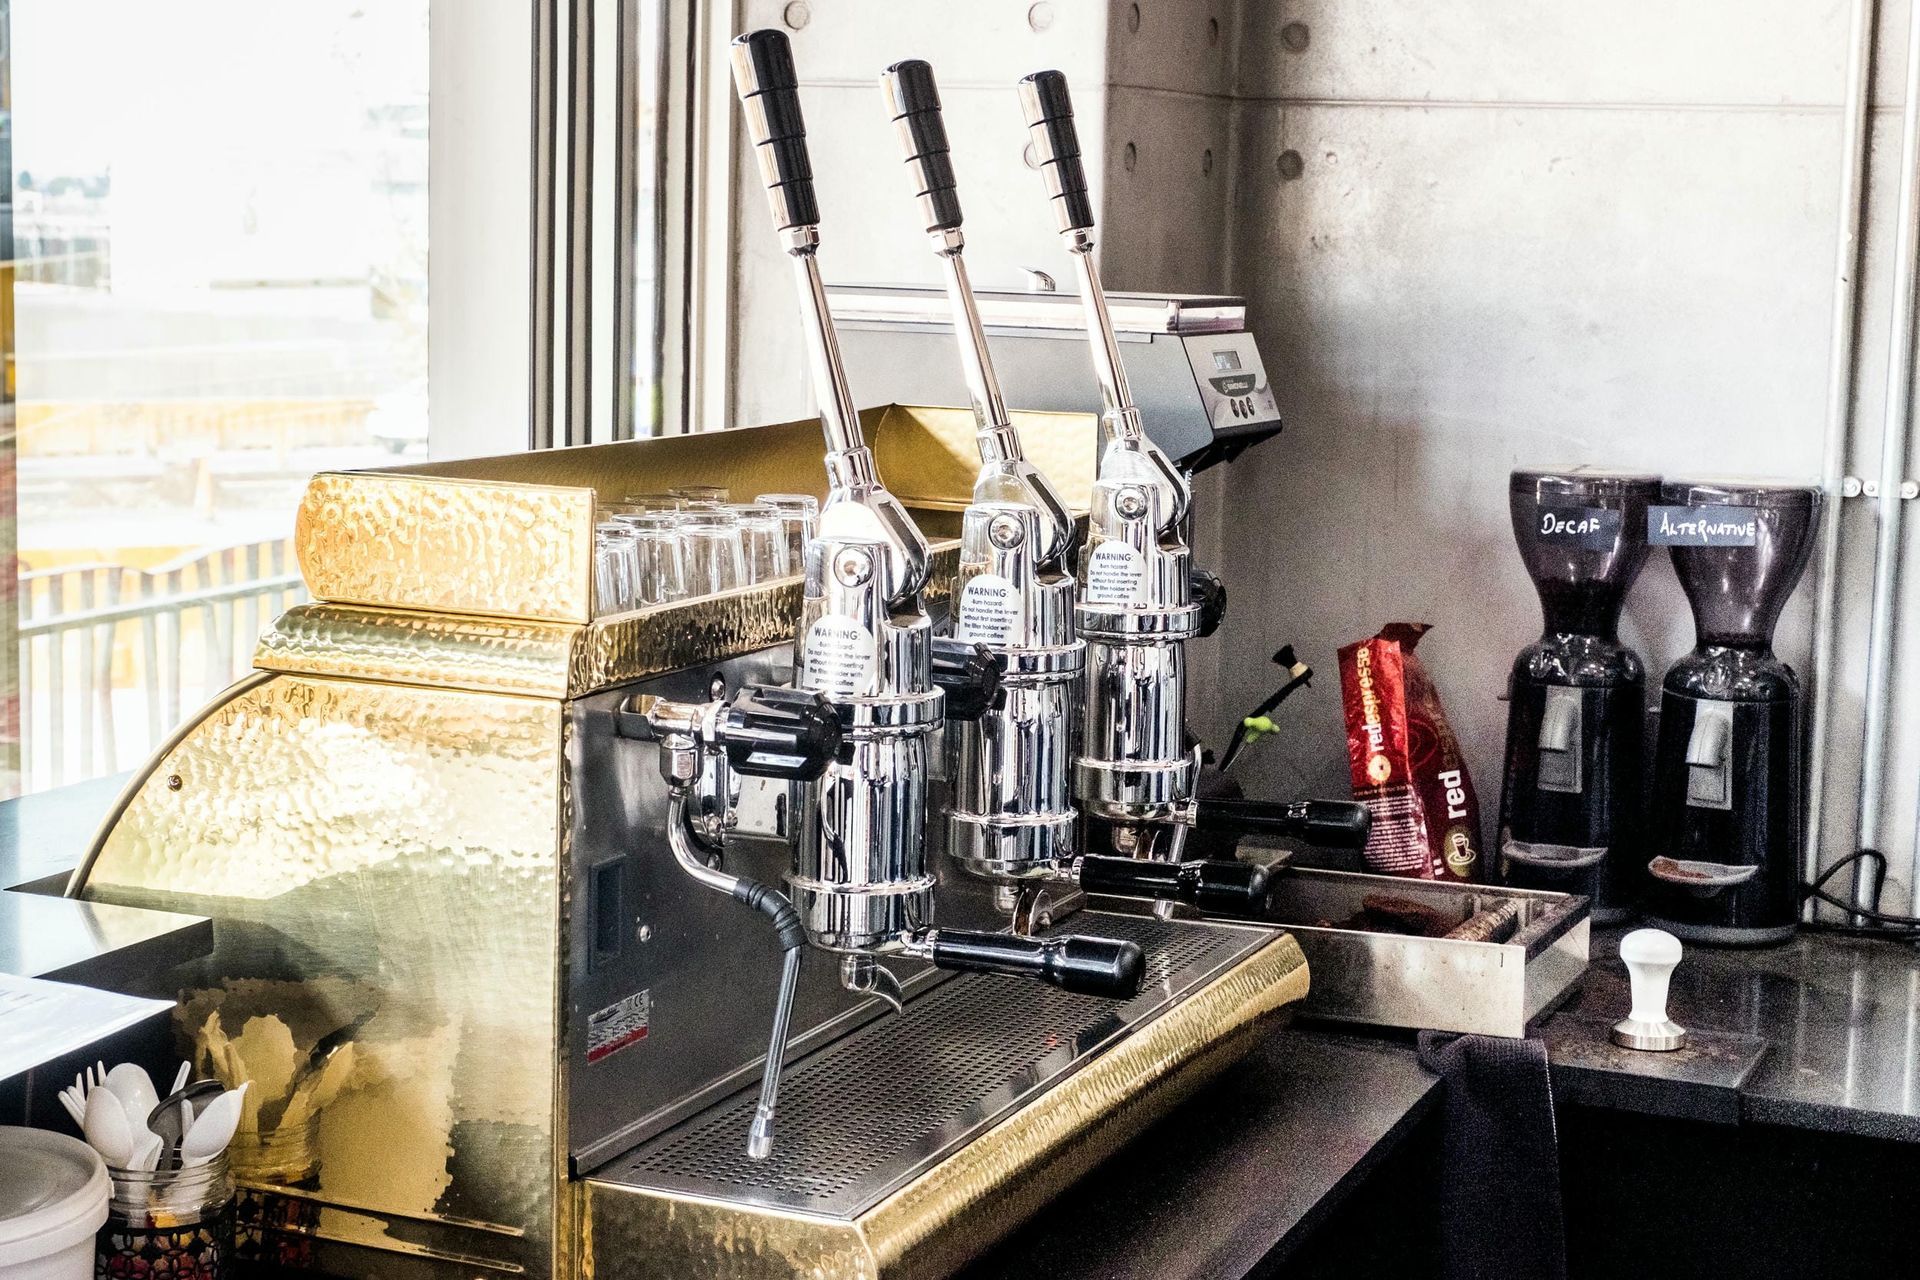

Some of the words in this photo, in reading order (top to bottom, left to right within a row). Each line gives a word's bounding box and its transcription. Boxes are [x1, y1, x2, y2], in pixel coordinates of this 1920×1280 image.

[1541, 513, 1600, 534] DECAF
[1660, 512, 1756, 543] ALTERNATIVE
[1096, 553, 1133, 561] WARNING:
[968, 586, 1008, 597] WARNING:
